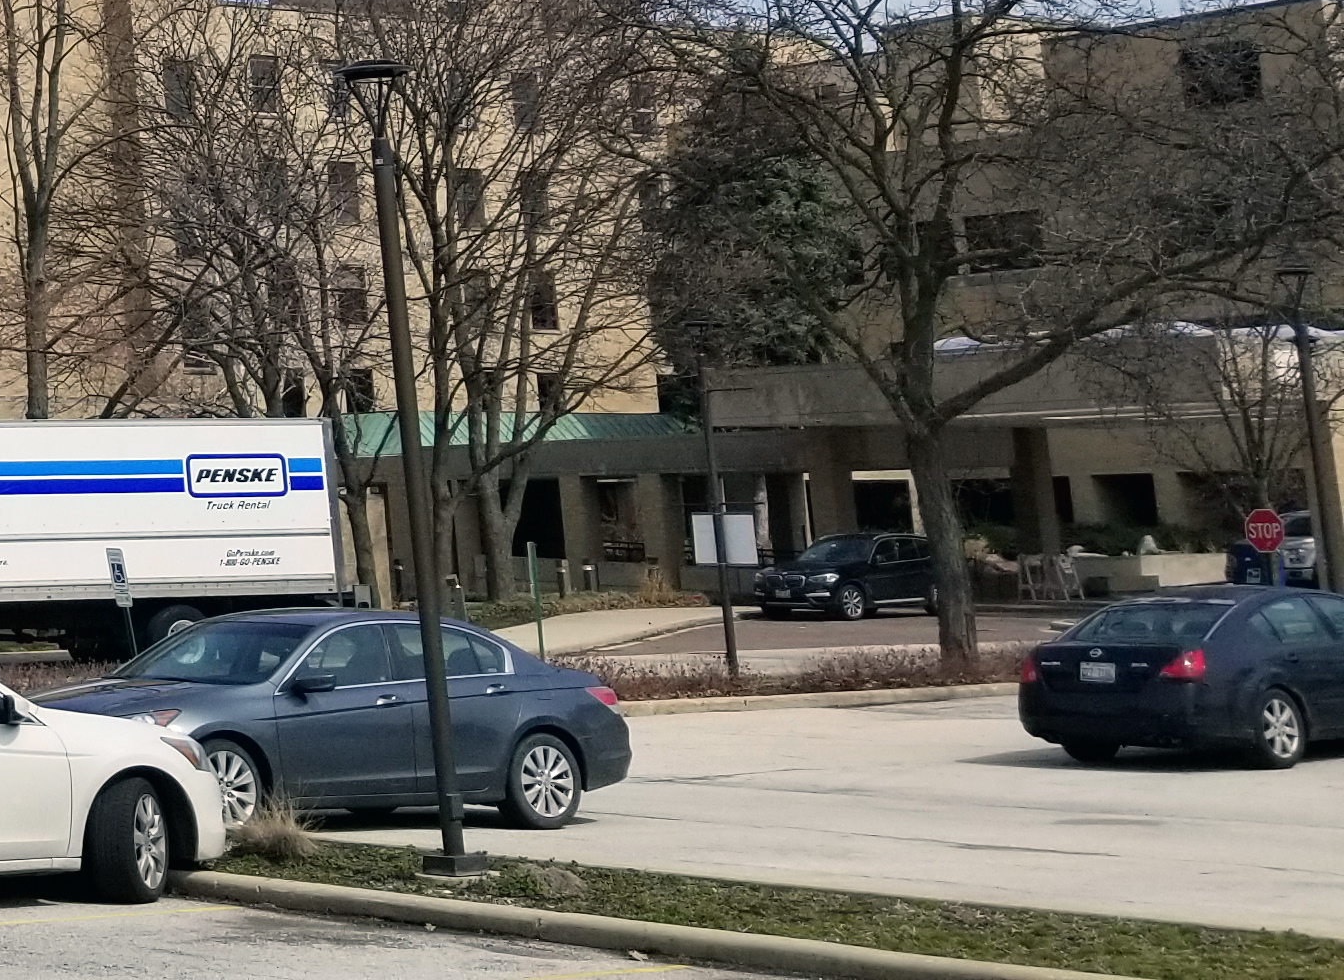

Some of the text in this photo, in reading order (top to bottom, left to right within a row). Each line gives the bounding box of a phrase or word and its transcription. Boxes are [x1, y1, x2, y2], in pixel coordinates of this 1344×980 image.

[196, 468, 279, 483] PENSKE
[206, 500, 271, 510] Truck Rental
[1248, 523, 1281, 538] STOP
